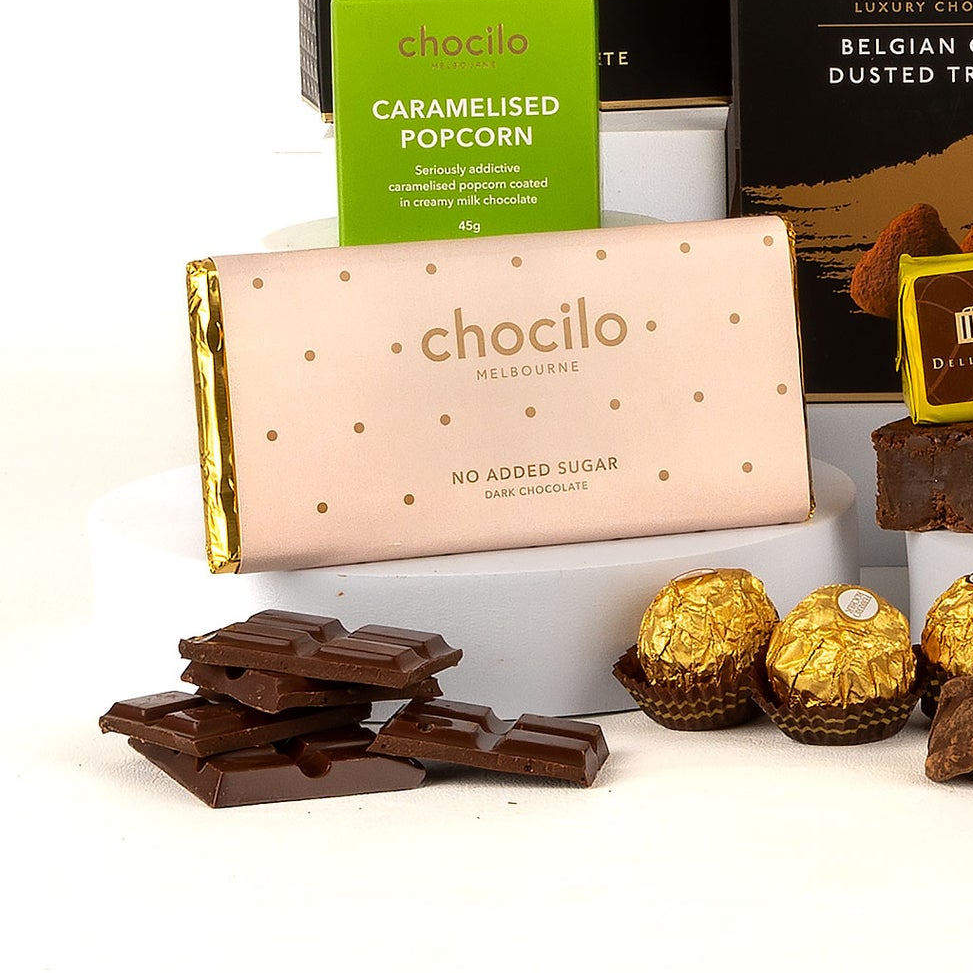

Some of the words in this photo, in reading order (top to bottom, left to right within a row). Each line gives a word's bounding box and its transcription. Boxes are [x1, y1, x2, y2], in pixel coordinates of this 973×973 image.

[855, 2, 925, 12] LUXURY
[398, 24, 529, 58] chocilo
[842, 38, 954, 54] BELGIAN
[830, 67, 933, 83] DUSTED
[372, 96, 559, 119] CARAMELISED
[402, 127, 532, 148] POPCORN
[416, 164, 466, 177] Seriously
[469, 163, 520, 174] addictive
[389, 180, 455, 191] caramelised
[459, 179, 506, 192] popcorn
[510, 177, 547, 188] coated
[400, 198, 410, 207] in
[414, 199, 453, 208] creamy
[457, 195, 480, 205] milk
[483, 194, 537, 205] chocolate
[459, 221, 480, 233] 45g
[421, 297, 628, 362] chocilo
[477, 361, 579, 380] MELBOURNE
[453, 470, 479, 484] NO
[486, 463, 551, 482] ADDED
[558, 457, 617, 474] SUGAR
[485, 488, 515, 499] DARK
[519, 481, 588, 495] CHOCOLATE
